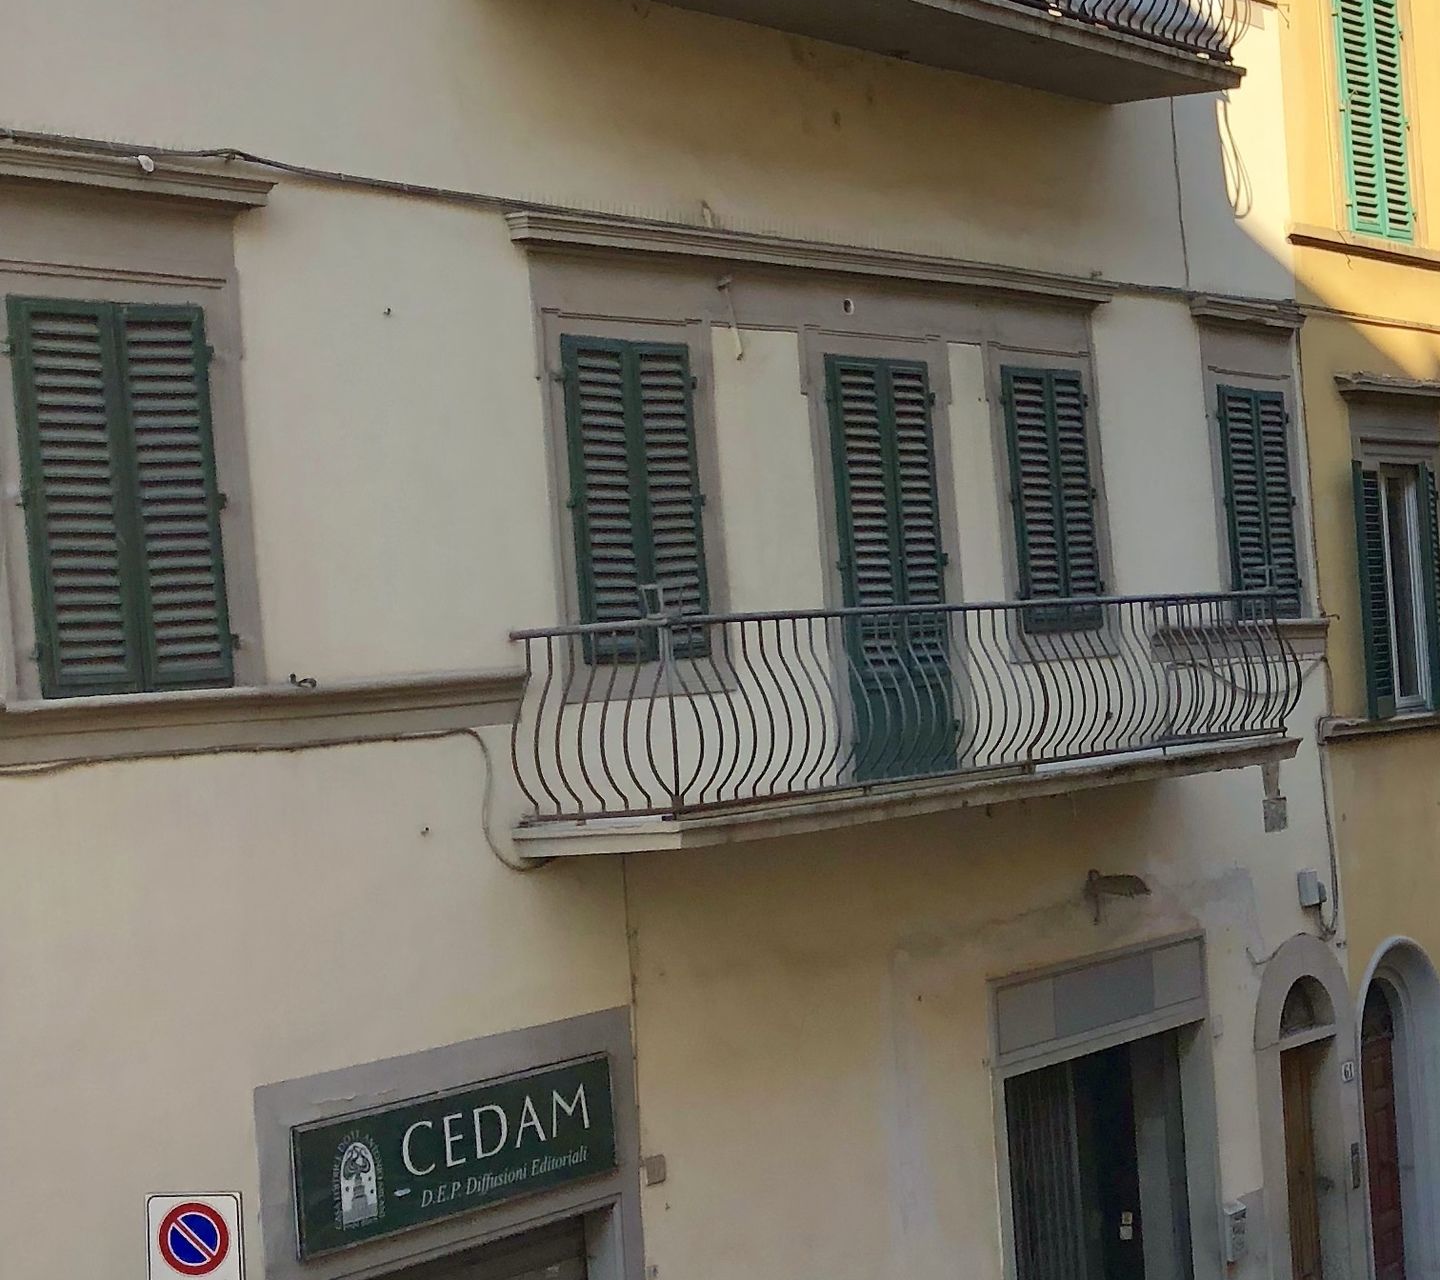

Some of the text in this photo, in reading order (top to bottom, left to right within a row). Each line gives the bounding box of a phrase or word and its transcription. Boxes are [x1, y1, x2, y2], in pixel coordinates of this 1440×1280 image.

[402, 1083, 590, 1176] CEDAM
[465, 1162, 527, 1196] Diffusioni
[531, 1145, 588, 1177] Editoriali
